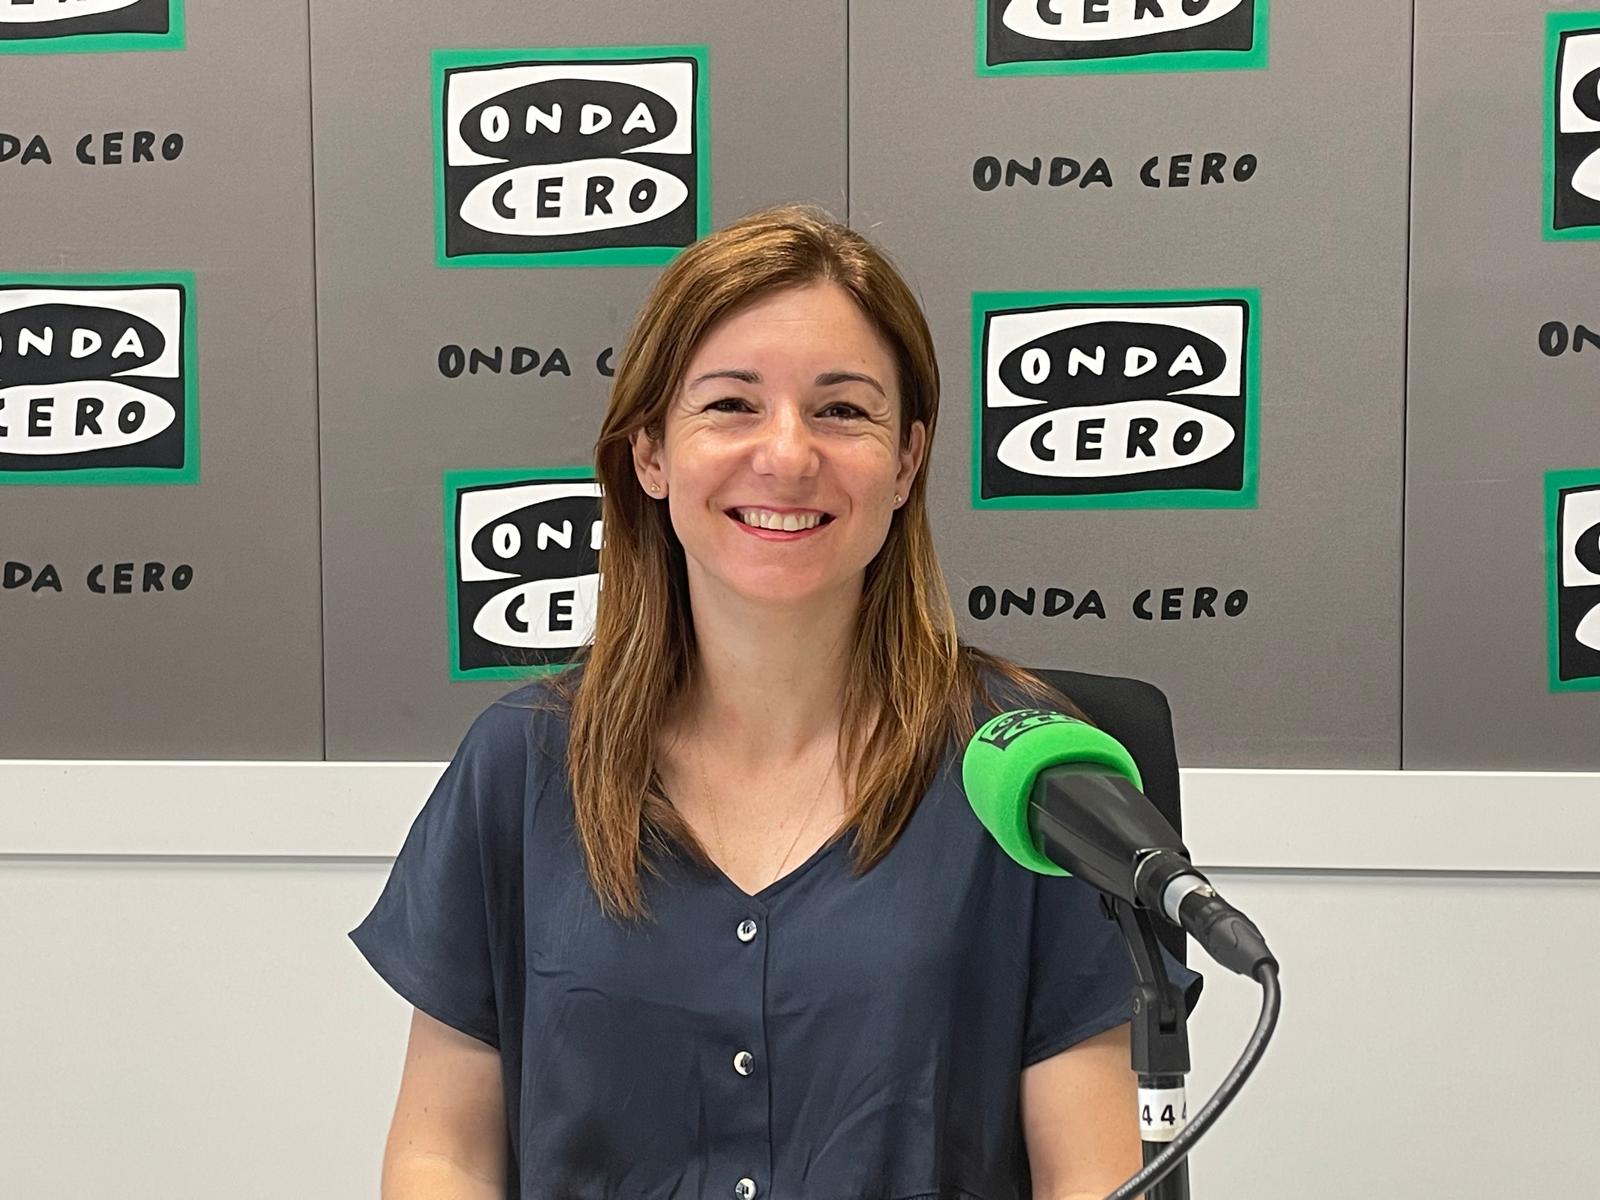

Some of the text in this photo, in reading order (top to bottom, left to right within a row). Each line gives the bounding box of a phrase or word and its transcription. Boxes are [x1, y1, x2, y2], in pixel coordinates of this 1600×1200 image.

[479, 102, 656, 143] ONDA
[75, 130, 184, 166] CERO
[972, 153, 1258, 192] ONDA CERO
[492, 175, 658, 220] CERO
[0, 326, 145, 359] NDA
[437, 344, 572, 379] ONDA
[1020, 344, 1204, 385] ONDA
[1029, 417, 1204, 462] CERO
[492, 519, 605, 559] ON
[86, 561, 194, 595] CERO
[504, 590, 575, 634] CE
[968, 585, 1249, 621] ONDA CERO
